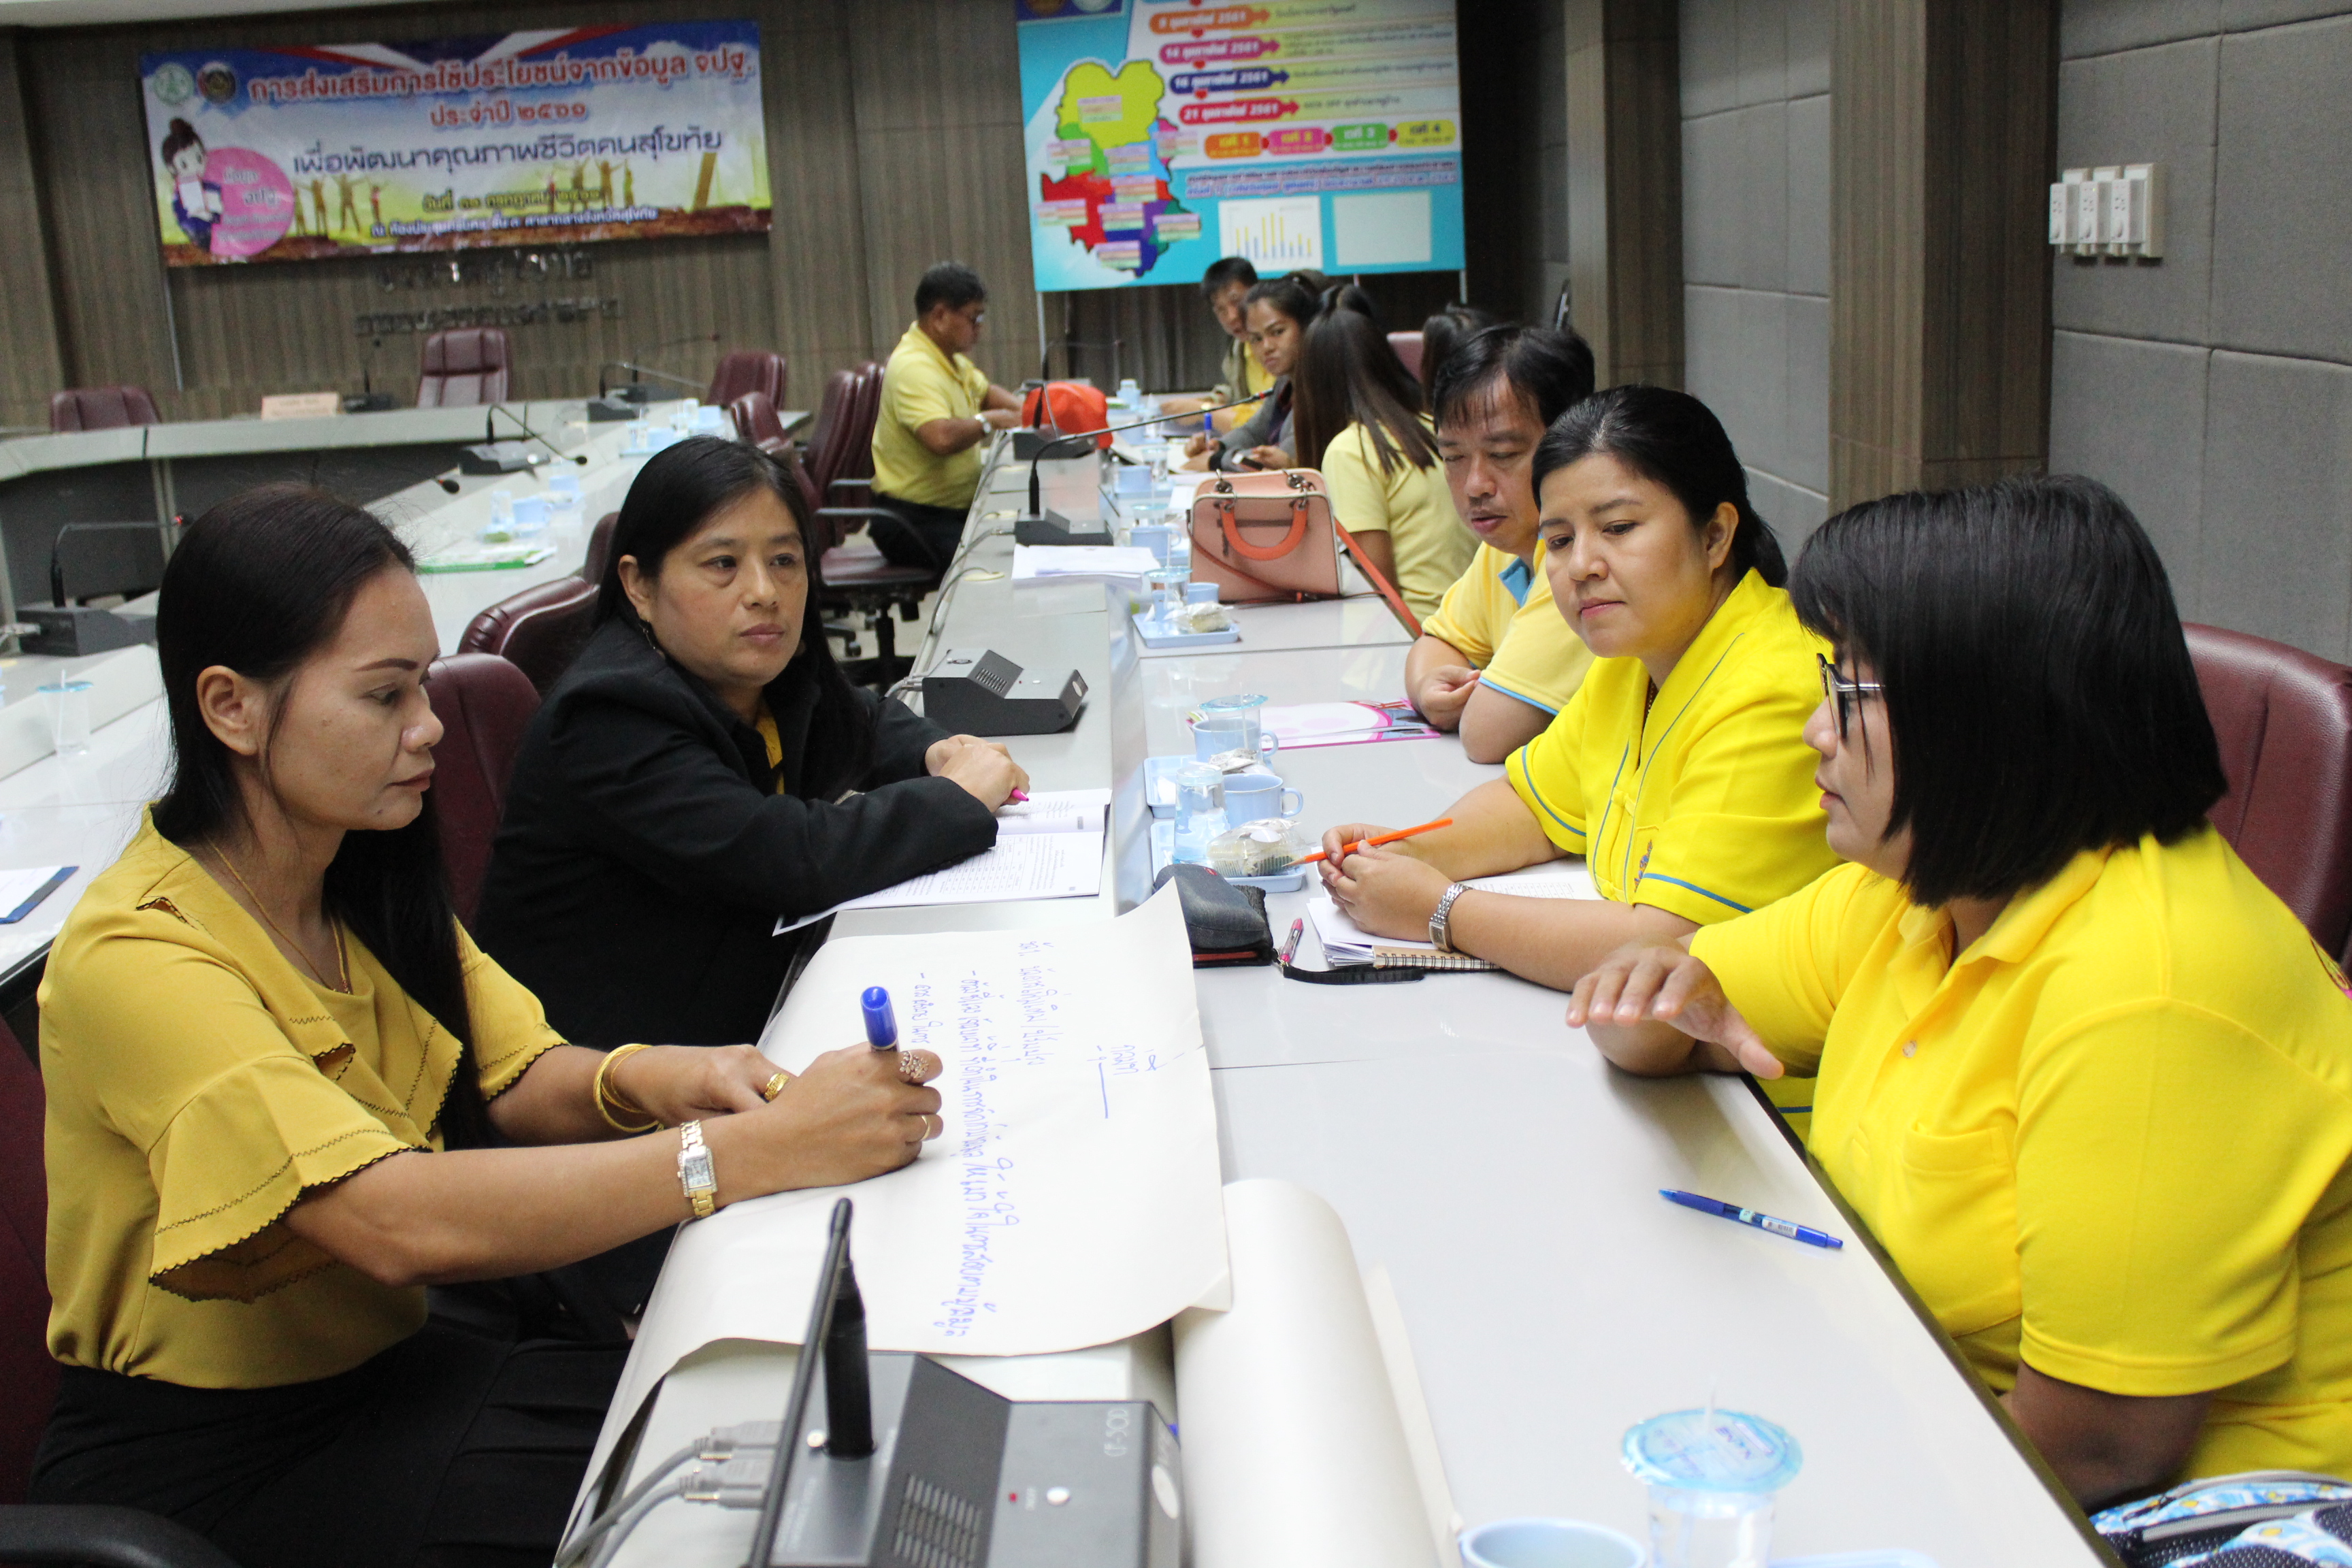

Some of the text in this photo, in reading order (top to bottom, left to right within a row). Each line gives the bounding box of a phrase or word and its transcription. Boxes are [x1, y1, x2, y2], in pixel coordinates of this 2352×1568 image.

[250, 50, 687, 101] การส่งเสริมการใช้ประโยชน์จากข้อมูล
[429, 99, 587, 127] ประจำปี ๒๕๖๑
[293, 125, 723, 174] เพื่อพัฒนาคุณภาพชีวิตคนสุโขทัย
